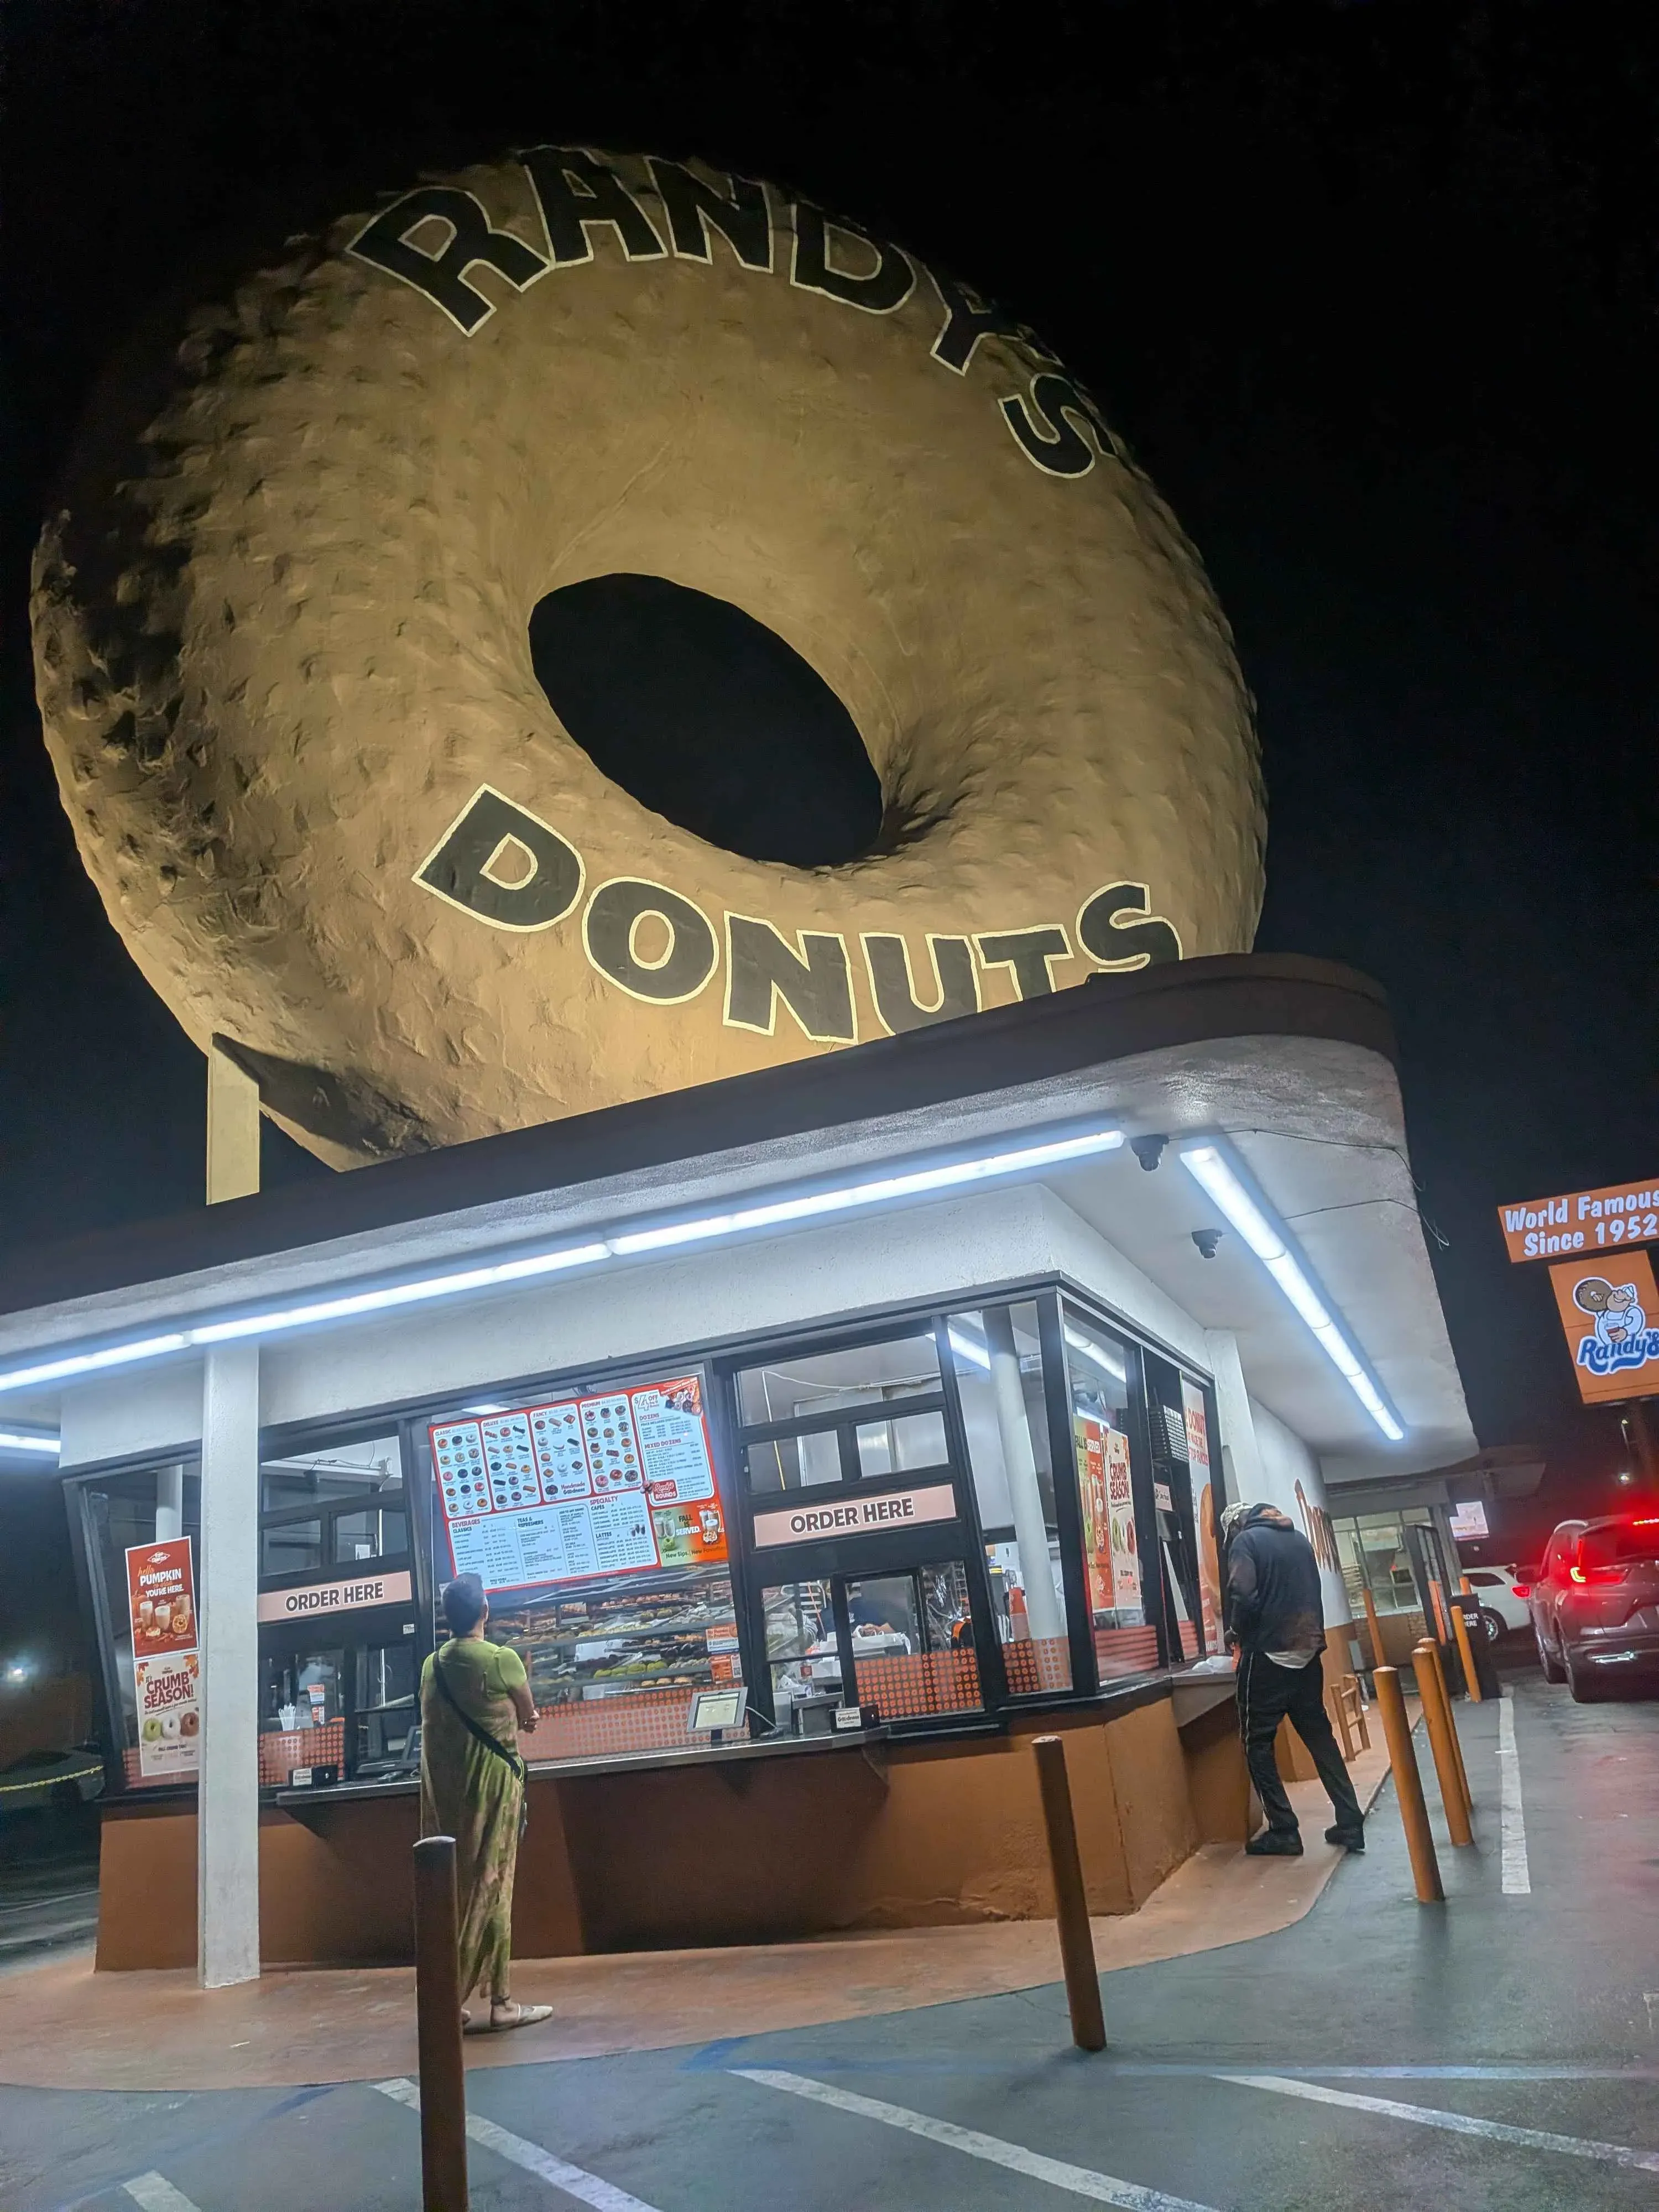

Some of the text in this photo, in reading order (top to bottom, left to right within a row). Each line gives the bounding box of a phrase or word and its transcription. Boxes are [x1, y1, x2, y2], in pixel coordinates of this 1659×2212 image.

[412, 783, 1185, 1045] DONUTS
[1505, 1190, 1659, 1233] World Famous
[1524, 1213, 1658, 1257] Since 1952
[1109, 1462, 1127, 1481] CRUMB
[589, 1496, 618, 1505] SPECIALTY
[452, 1519, 481, 1528] BEVERAGES
[790, 1497, 915, 1533] ORDER HERE
[140, 1568, 182, 1587] PUMPKIN
[285, 1582, 383, 1611] ORDER HERE
[147, 1671, 190, 1694] CRUMB
[144, 1684, 194, 1709] SEASON!
